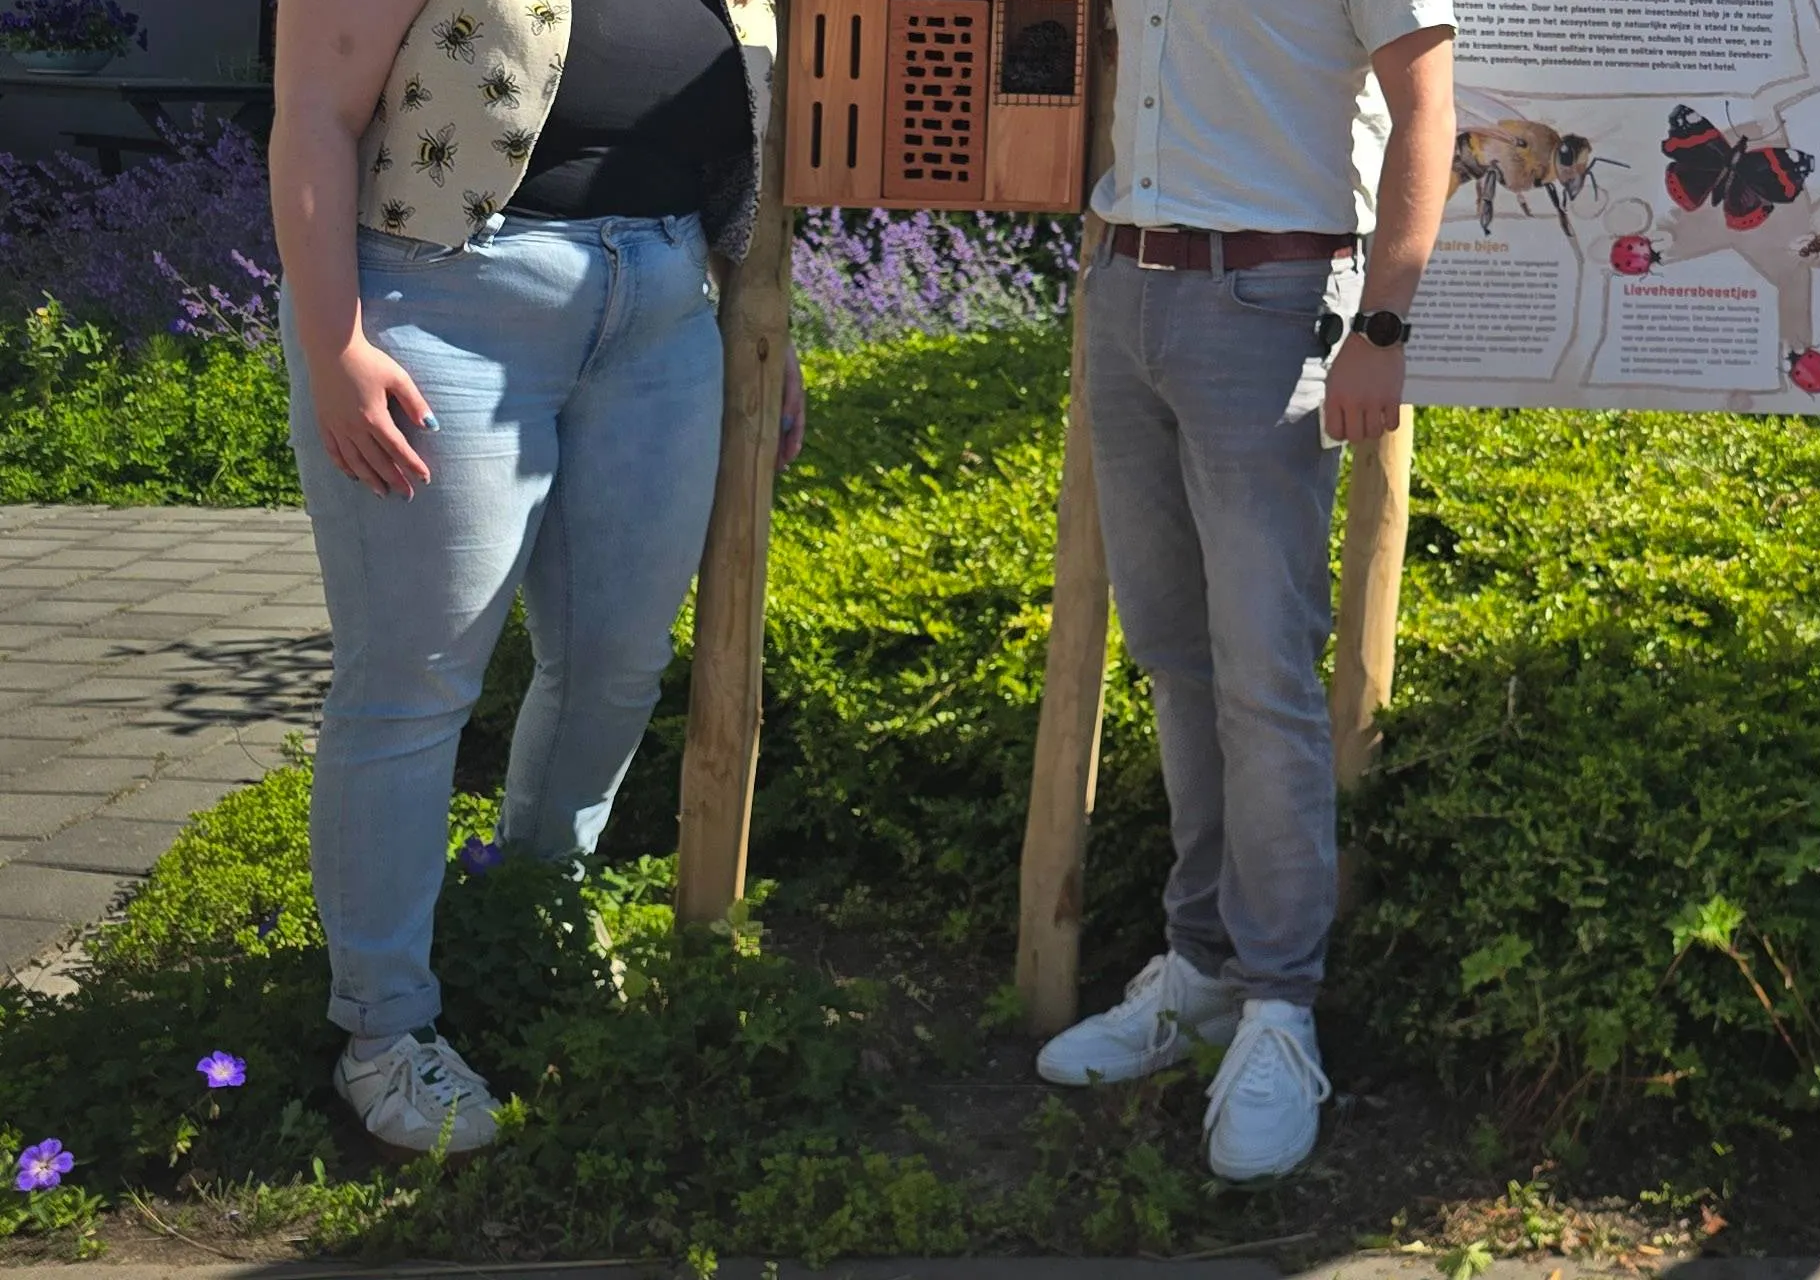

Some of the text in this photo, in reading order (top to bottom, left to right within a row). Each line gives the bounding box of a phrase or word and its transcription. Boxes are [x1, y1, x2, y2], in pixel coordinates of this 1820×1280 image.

[1531, 3, 1551, 12] Door
[1570, 5, 1606, 15] plaatsen
[1644, 8, 1700, 17] insectenhotel
[1702, 9, 1720, 19] help
[1722, 11, 1730, 20] je
[1476, 15, 1495, 24] help
[1496, 16, 1505, 25] je
[1559, 18, 1609, 28] ecosysteem
[1624, 20, 1668, 30] natuurlijke
[1669, 22, 1691, 31] wijze
[1704, 23, 1728, 31] stand
[1497, 29, 1534, 38] insecten
[1536, 30, 1567, 39] kunnen
[1647, 34, 1681, 43] schuilen
[1683, 35, 1694, 45] bij
[1696, 36, 1722, 44] slecht
[1532, 44, 1558, 52] Naast
[1560, 44, 1594, 53] solitaire
[1596, 45, 1616, 55] bijen
[1630, 47, 1664, 55] solitaire
[1666, 50, 1697, 58] wespen
[1728, 50, 1773, 59] lieveheers-
[1540, 57, 1592, 67] pissebedden
[1651, 61, 1681, 71] gebruik
[1624, 284, 1757, 300] Lieveheersbeestjes
